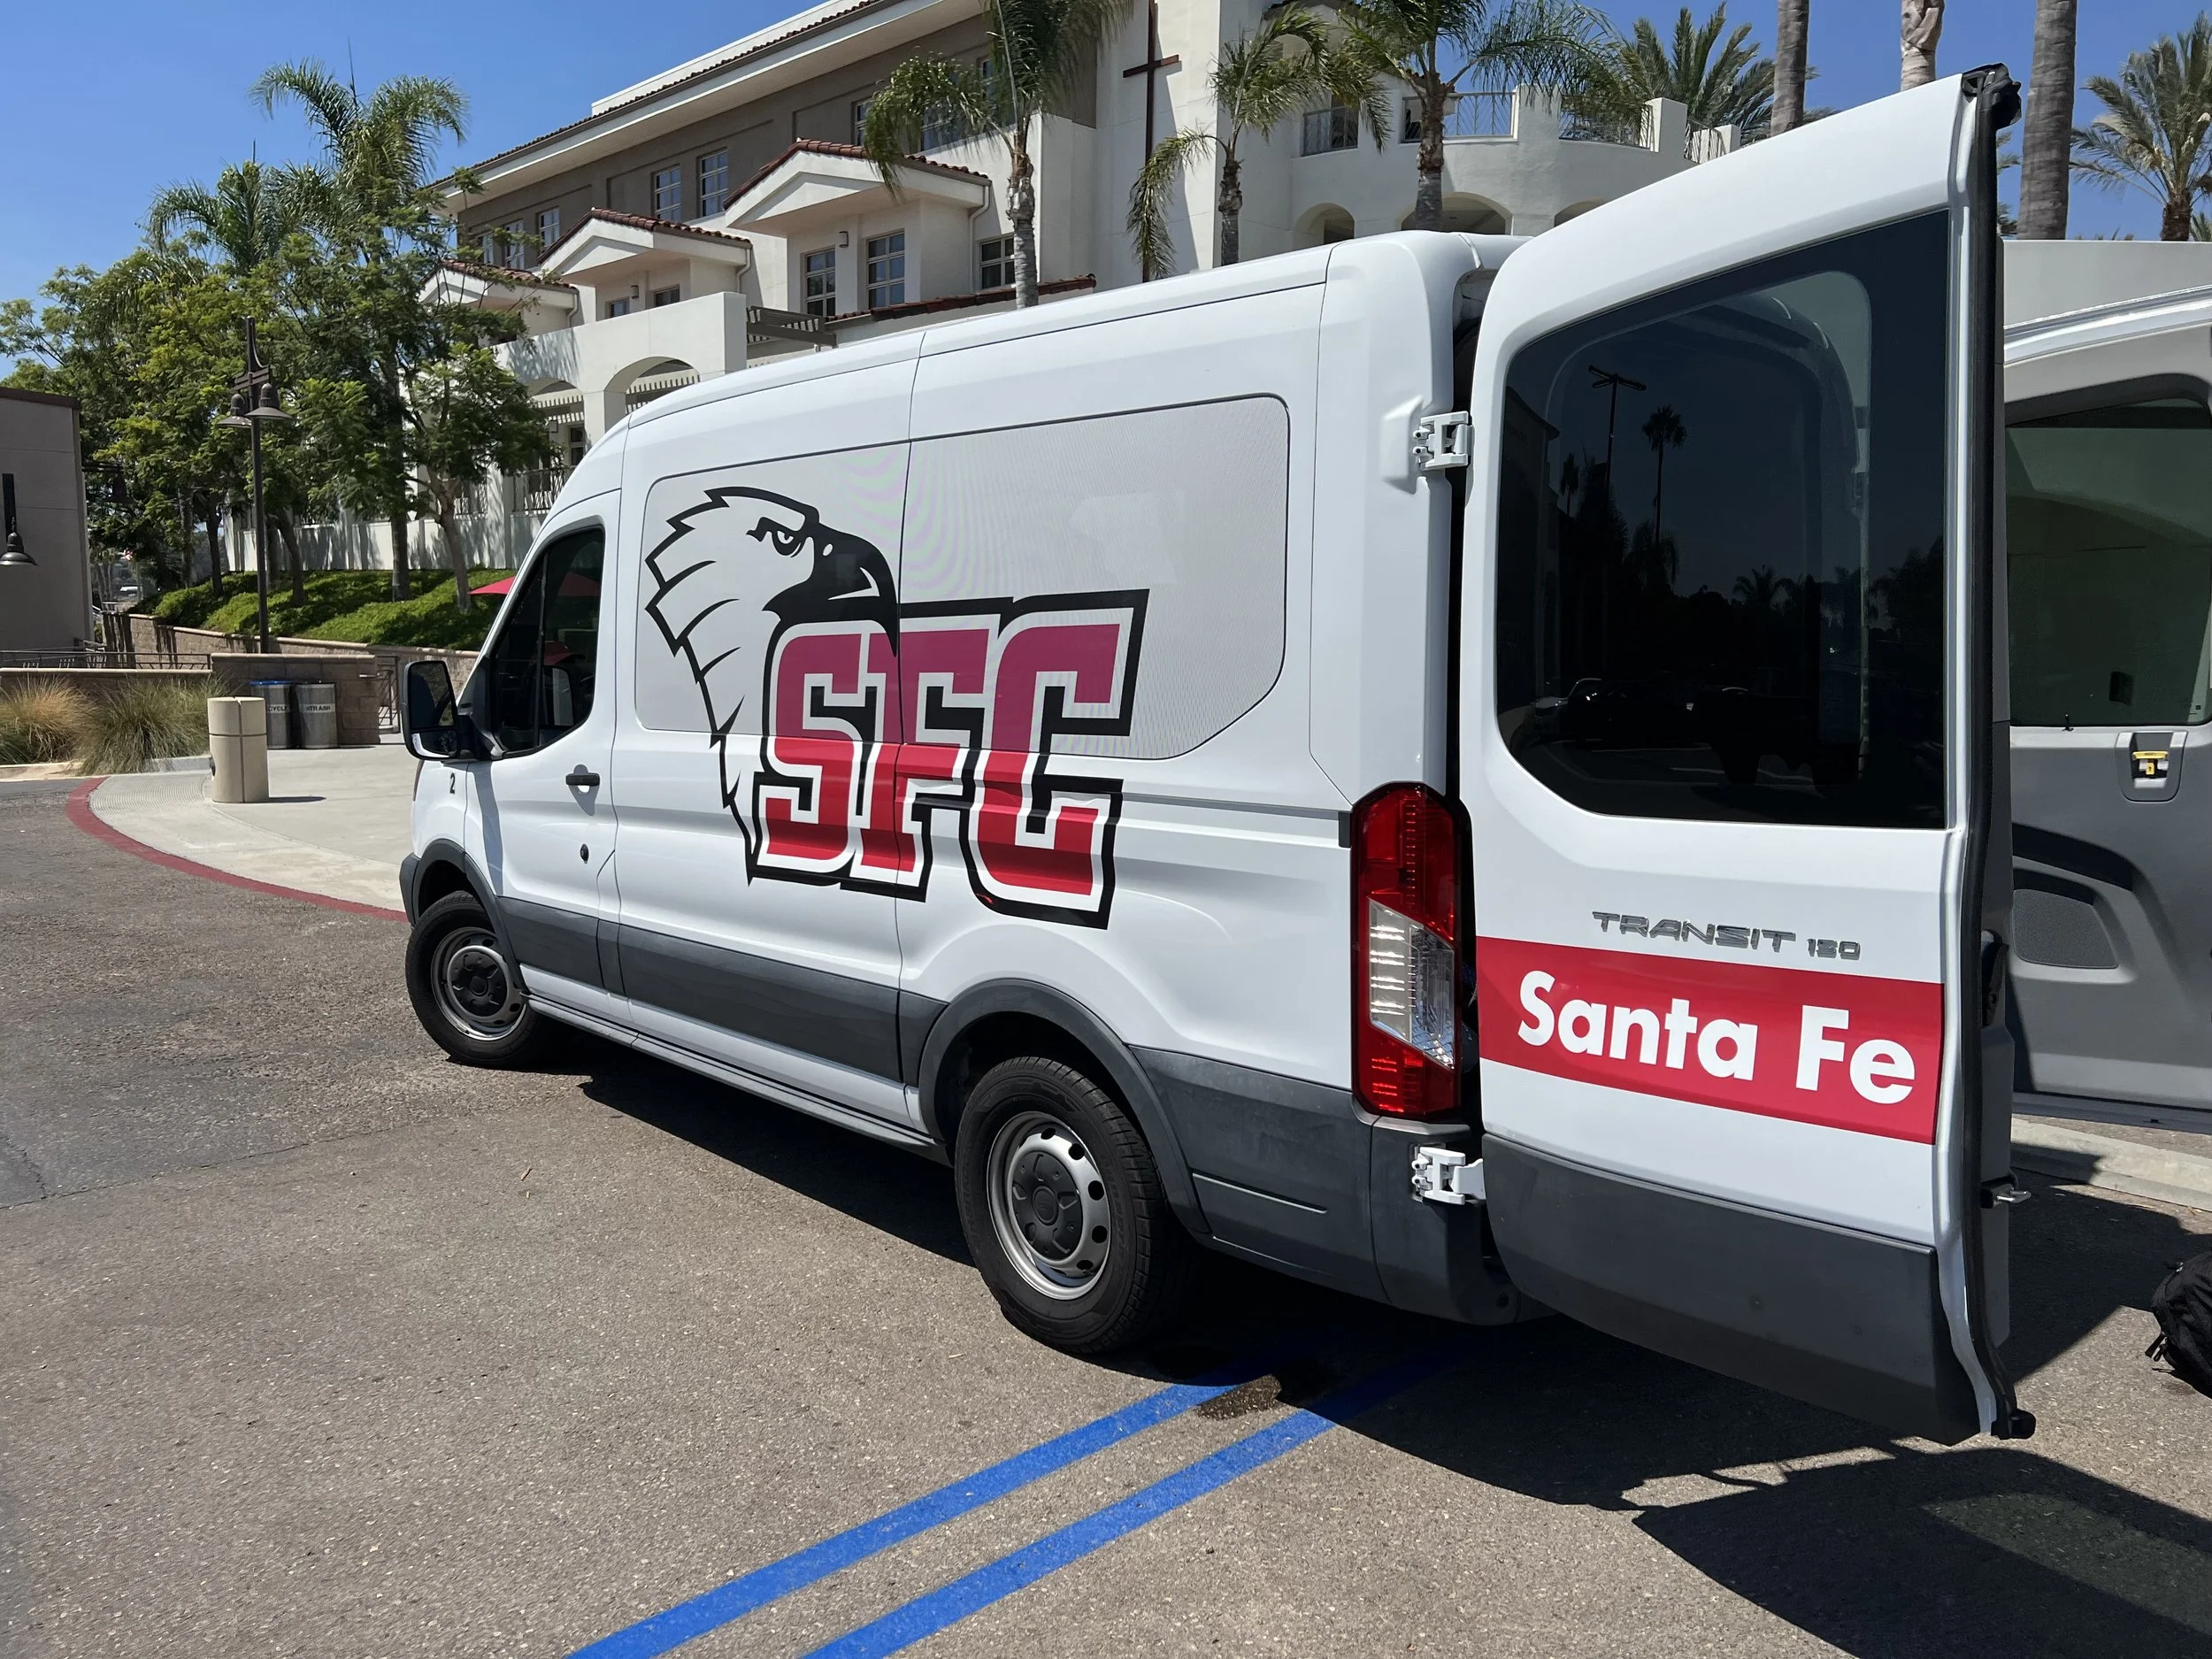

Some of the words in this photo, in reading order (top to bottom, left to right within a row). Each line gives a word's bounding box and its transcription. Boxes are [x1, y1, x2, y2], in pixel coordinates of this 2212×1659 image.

[449, 772, 456, 795] 2
[749, 589, 1149, 929] SFC
[1592, 911, 1796, 953] TRANSIT
[1807, 938, 1862, 961] 150
[1517, 970, 1759, 1081] Santa
[1795, 1004, 1916, 1105] Fe
